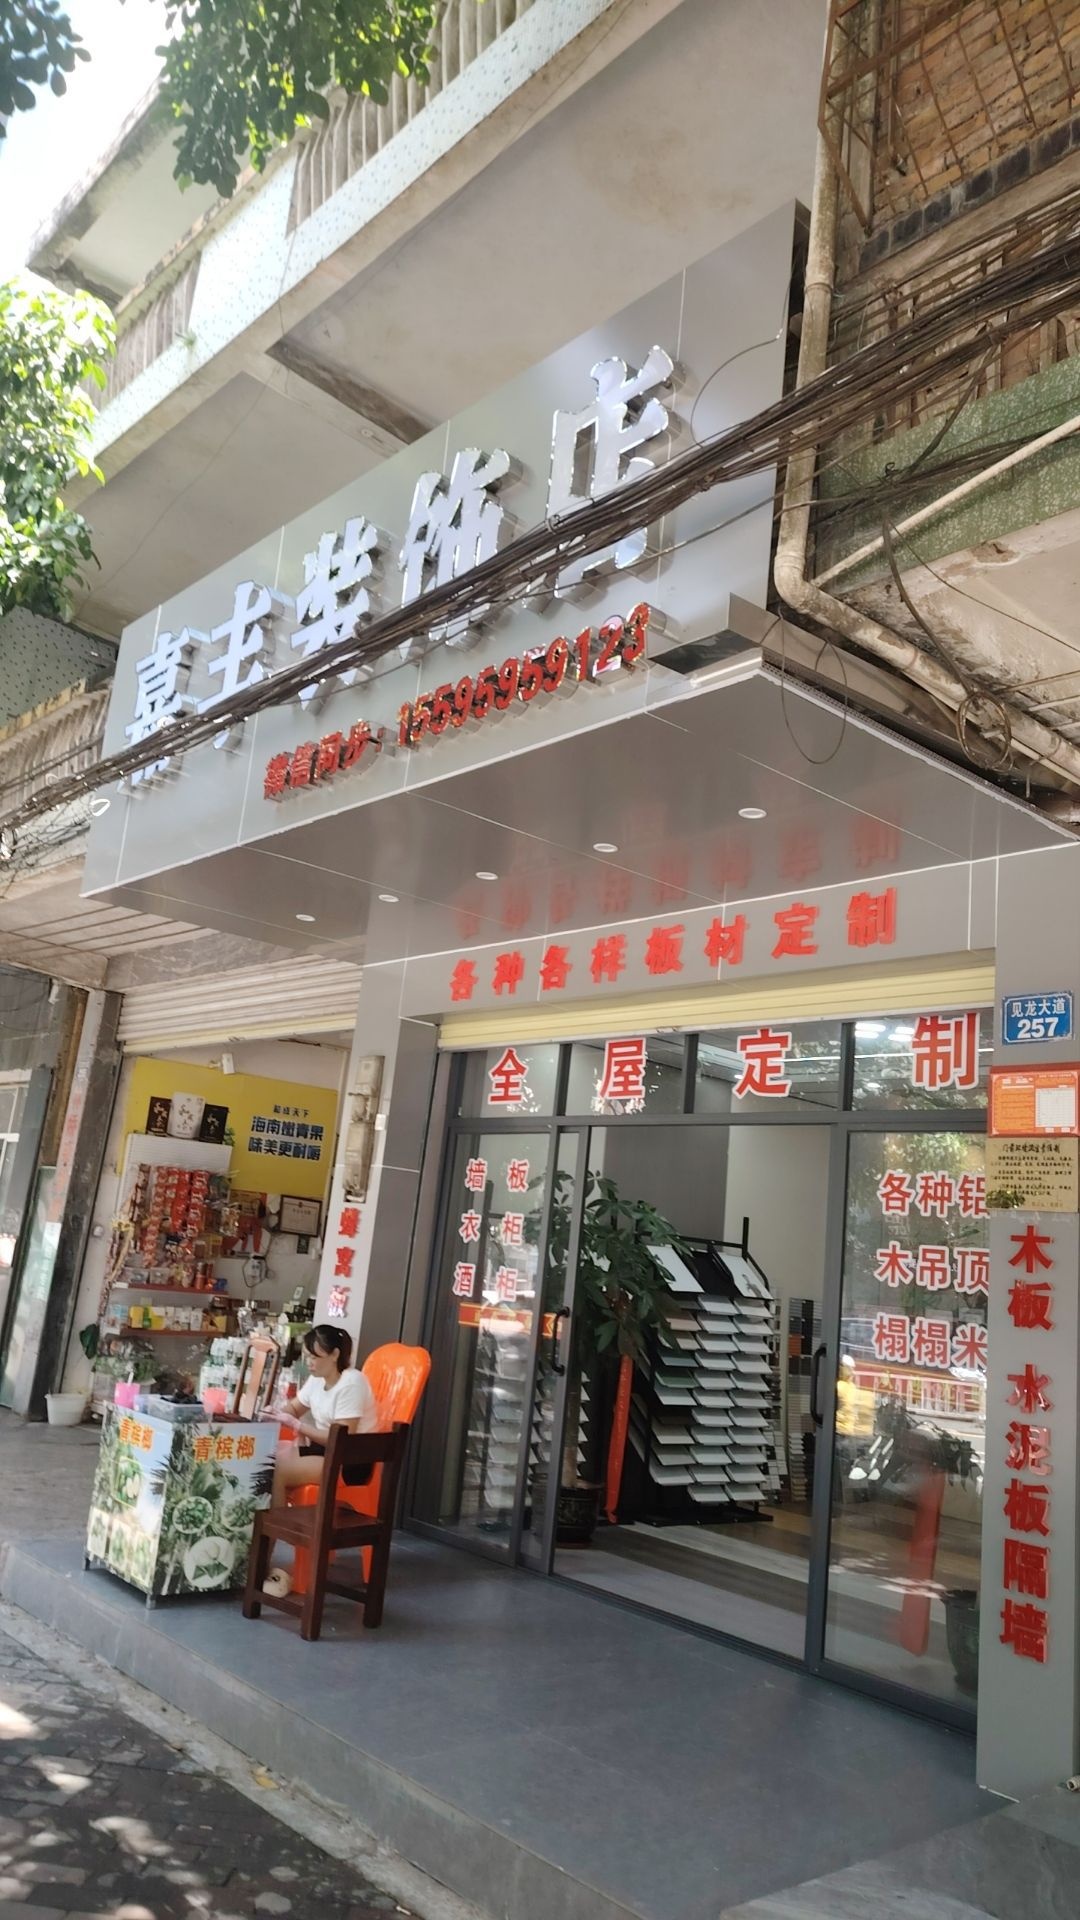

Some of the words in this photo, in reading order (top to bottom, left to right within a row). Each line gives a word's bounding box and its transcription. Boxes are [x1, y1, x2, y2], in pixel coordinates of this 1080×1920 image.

[450, 888, 897, 1001] 各种各样板材定制
[1011, 998, 1066, 1018] 见龙大道
[1017, 1017, 1059, 1039] 257
[488, 1012, 980, 1105] 全屋定制
[248, 1136, 321, 1161] 味美更耐嚼
[251, 1116, 324, 1141] 海南嫩青果
[465, 1158, 529, 1193] 墙板
[877, 1169, 990, 1218] 各种铝
[459, 1210, 525, 1246] 衣柜
[453, 1261, 518, 1302] 酒柜
[874, 1241, 989, 1295] 木吊顶
[1007, 1225, 1054, 1331] 木板
[872, 1312, 987, 1370] 榻榻米
[193, 1436, 256, 1461] 青槟榔
[1000, 1363, 1054, 1664] 水泥板隔墙
